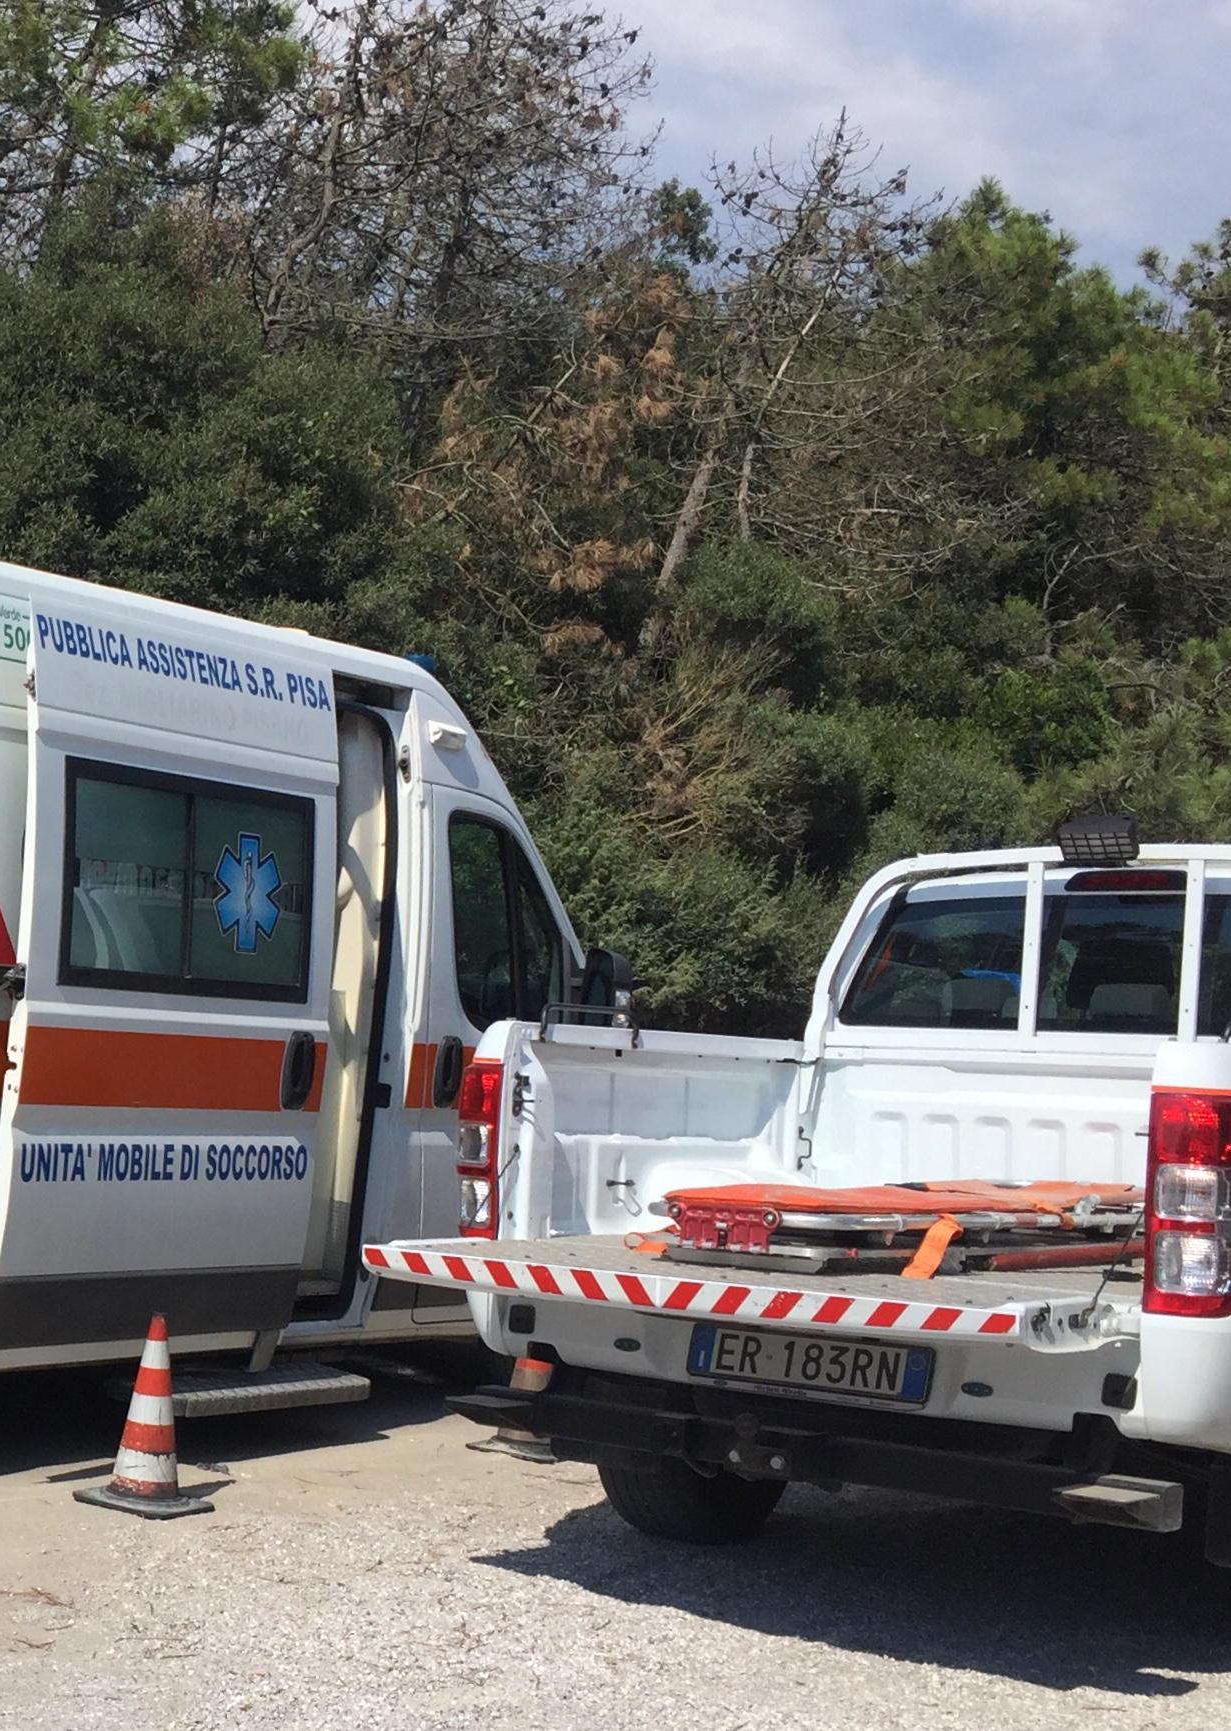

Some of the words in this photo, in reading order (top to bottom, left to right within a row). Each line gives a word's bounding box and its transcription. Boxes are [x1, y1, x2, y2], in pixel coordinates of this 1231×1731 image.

[36, 613, 133, 669] PUBBLICA
[136, 637, 243, 693] ASSISTENZA
[244, 662, 284, 702] S.R.
[285, 671, 332, 712] PISA
[20, 1143, 92, 1183] UNITA'
[97, 1143, 175, 1182] MOBILE
[179, 1144, 199, 1181] DI
[205, 1144, 308, 1182] SOCCORSO
[715, 1333, 762, 1375] ER
[783, 1340, 902, 1392] 183RN
